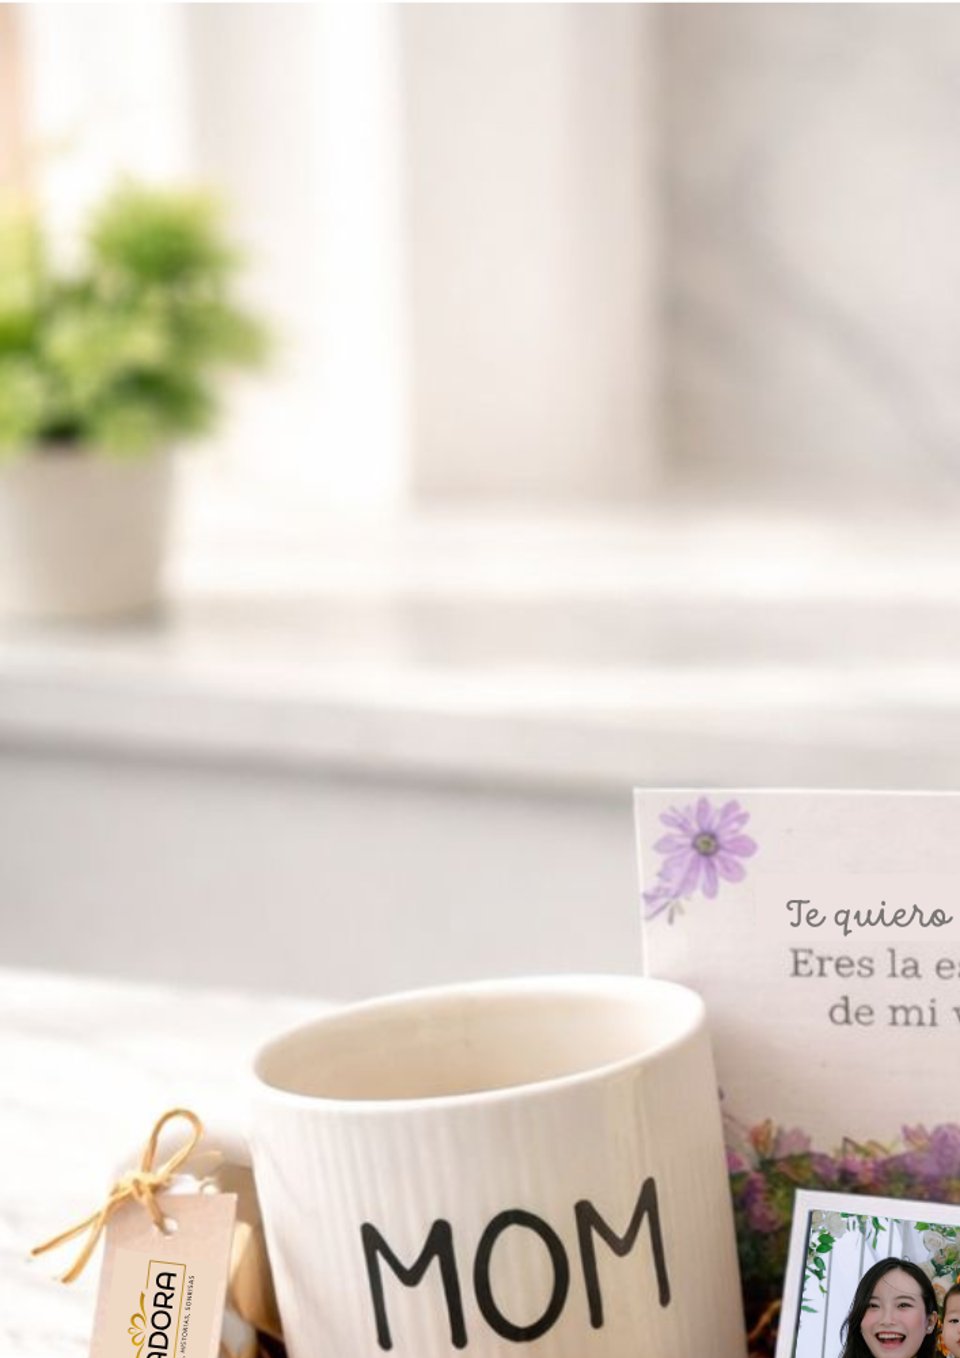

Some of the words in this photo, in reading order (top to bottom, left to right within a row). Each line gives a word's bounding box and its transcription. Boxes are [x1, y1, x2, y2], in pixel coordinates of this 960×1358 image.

[786, 899, 826, 928] Te
[834, 900, 954, 937] quiero
[789, 947, 875, 979] Eres
[886, 947, 922, 980] la
[828, 995, 875, 1027] de
[888, 998, 939, 1028] mi
[360, 1176, 671, 1351] MOM
